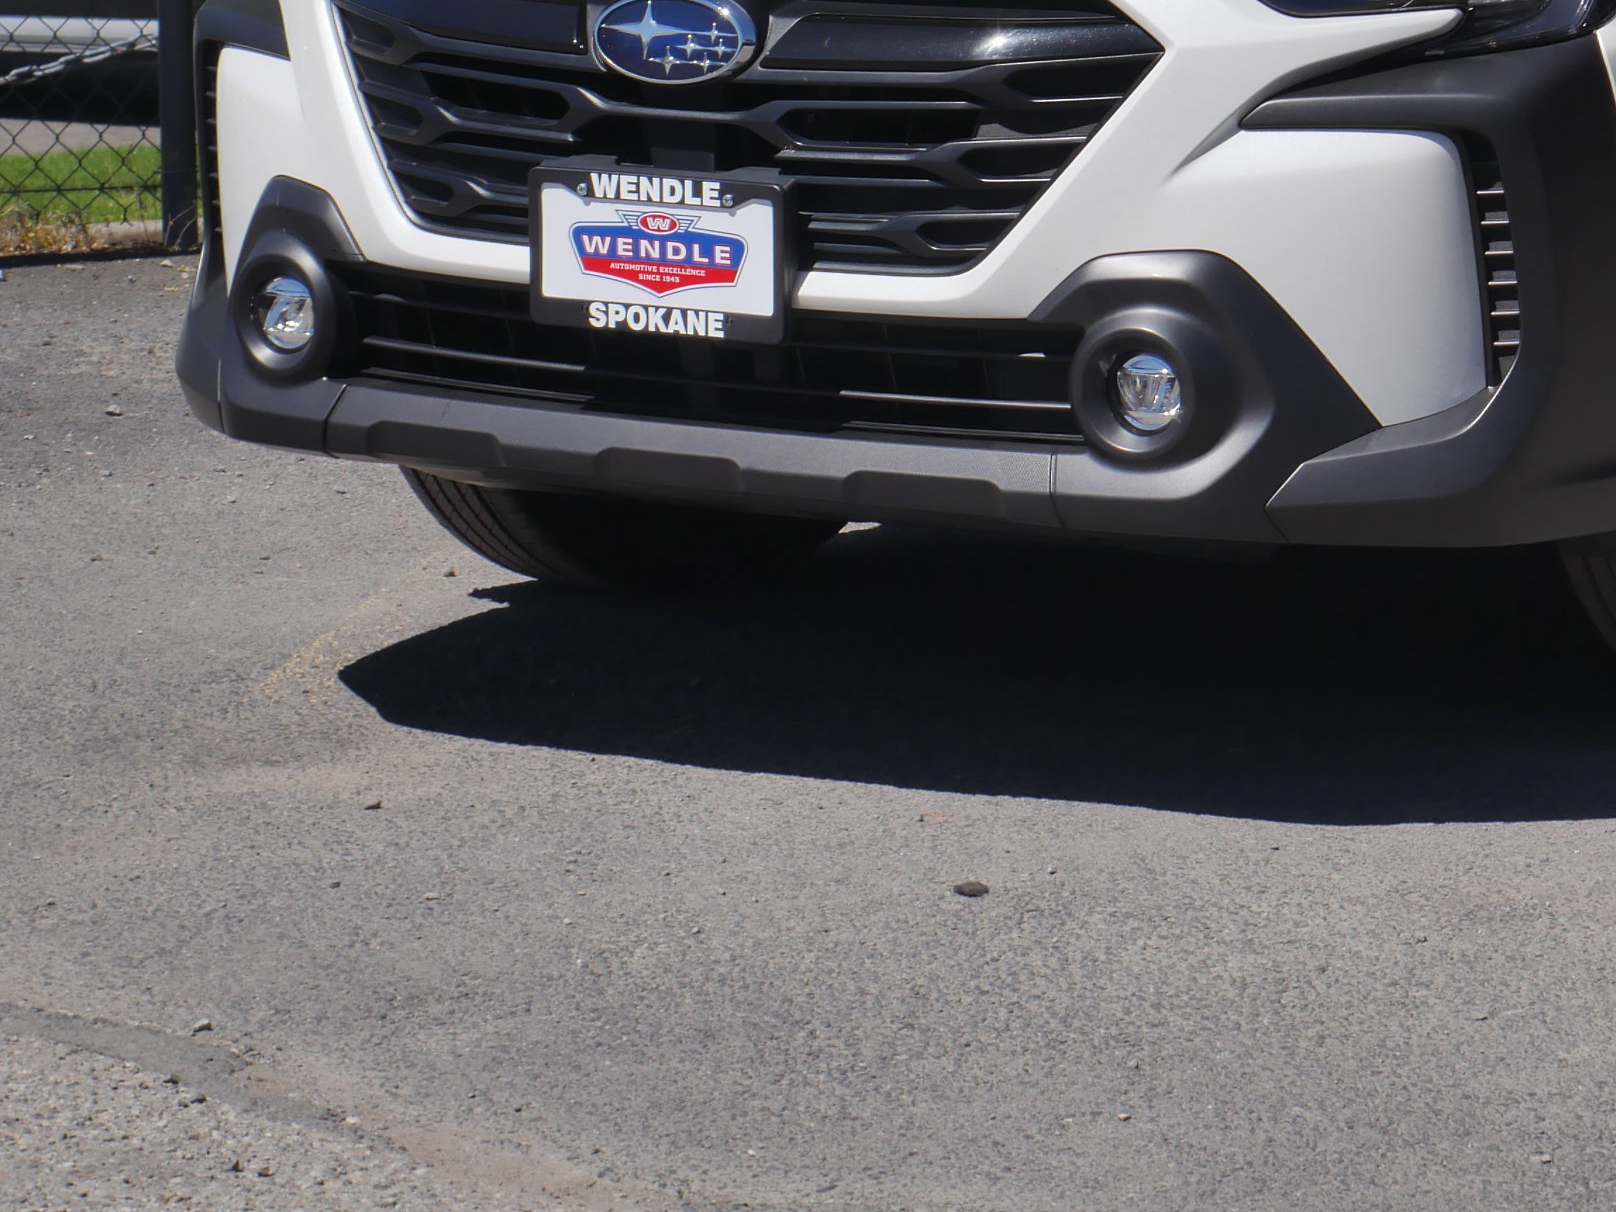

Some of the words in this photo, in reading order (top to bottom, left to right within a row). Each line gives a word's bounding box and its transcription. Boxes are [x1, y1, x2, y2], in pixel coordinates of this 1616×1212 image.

[589, 172, 721, 207] WENDLE
[581, 234, 732, 265] WENDLE
[609, 262, 658, 273] AUTOMOTIVE
[659, 266, 706, 277] EXCELLENCE
[638, 274, 661, 282] SINCE
[662, 275, 680, 283] 1943
[588, 301, 725, 338] SPOKANE
